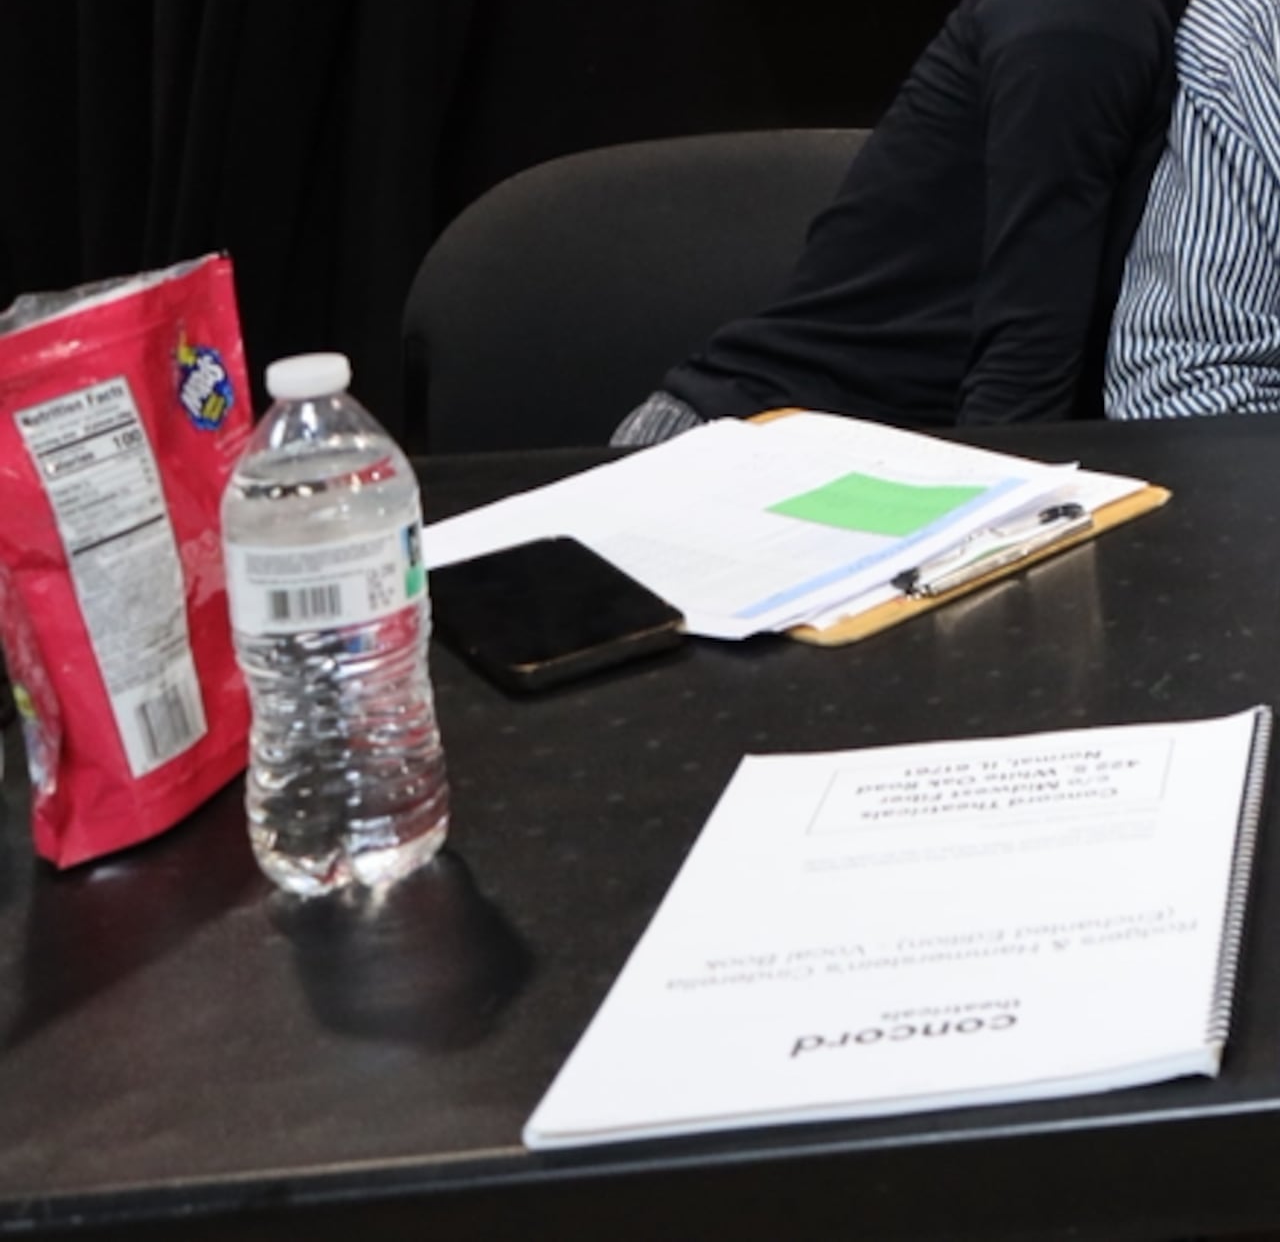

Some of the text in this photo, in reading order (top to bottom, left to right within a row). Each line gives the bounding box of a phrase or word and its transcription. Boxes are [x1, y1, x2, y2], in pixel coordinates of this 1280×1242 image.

[855, 780, 919, 795] Road
[950, 780, 1060, 798] Midwest
[860, 786, 1118, 820] Concord Theatricals
[880, 997, 1022, 1021] theatricals
[790, 1013, 1019, 1059] concord
